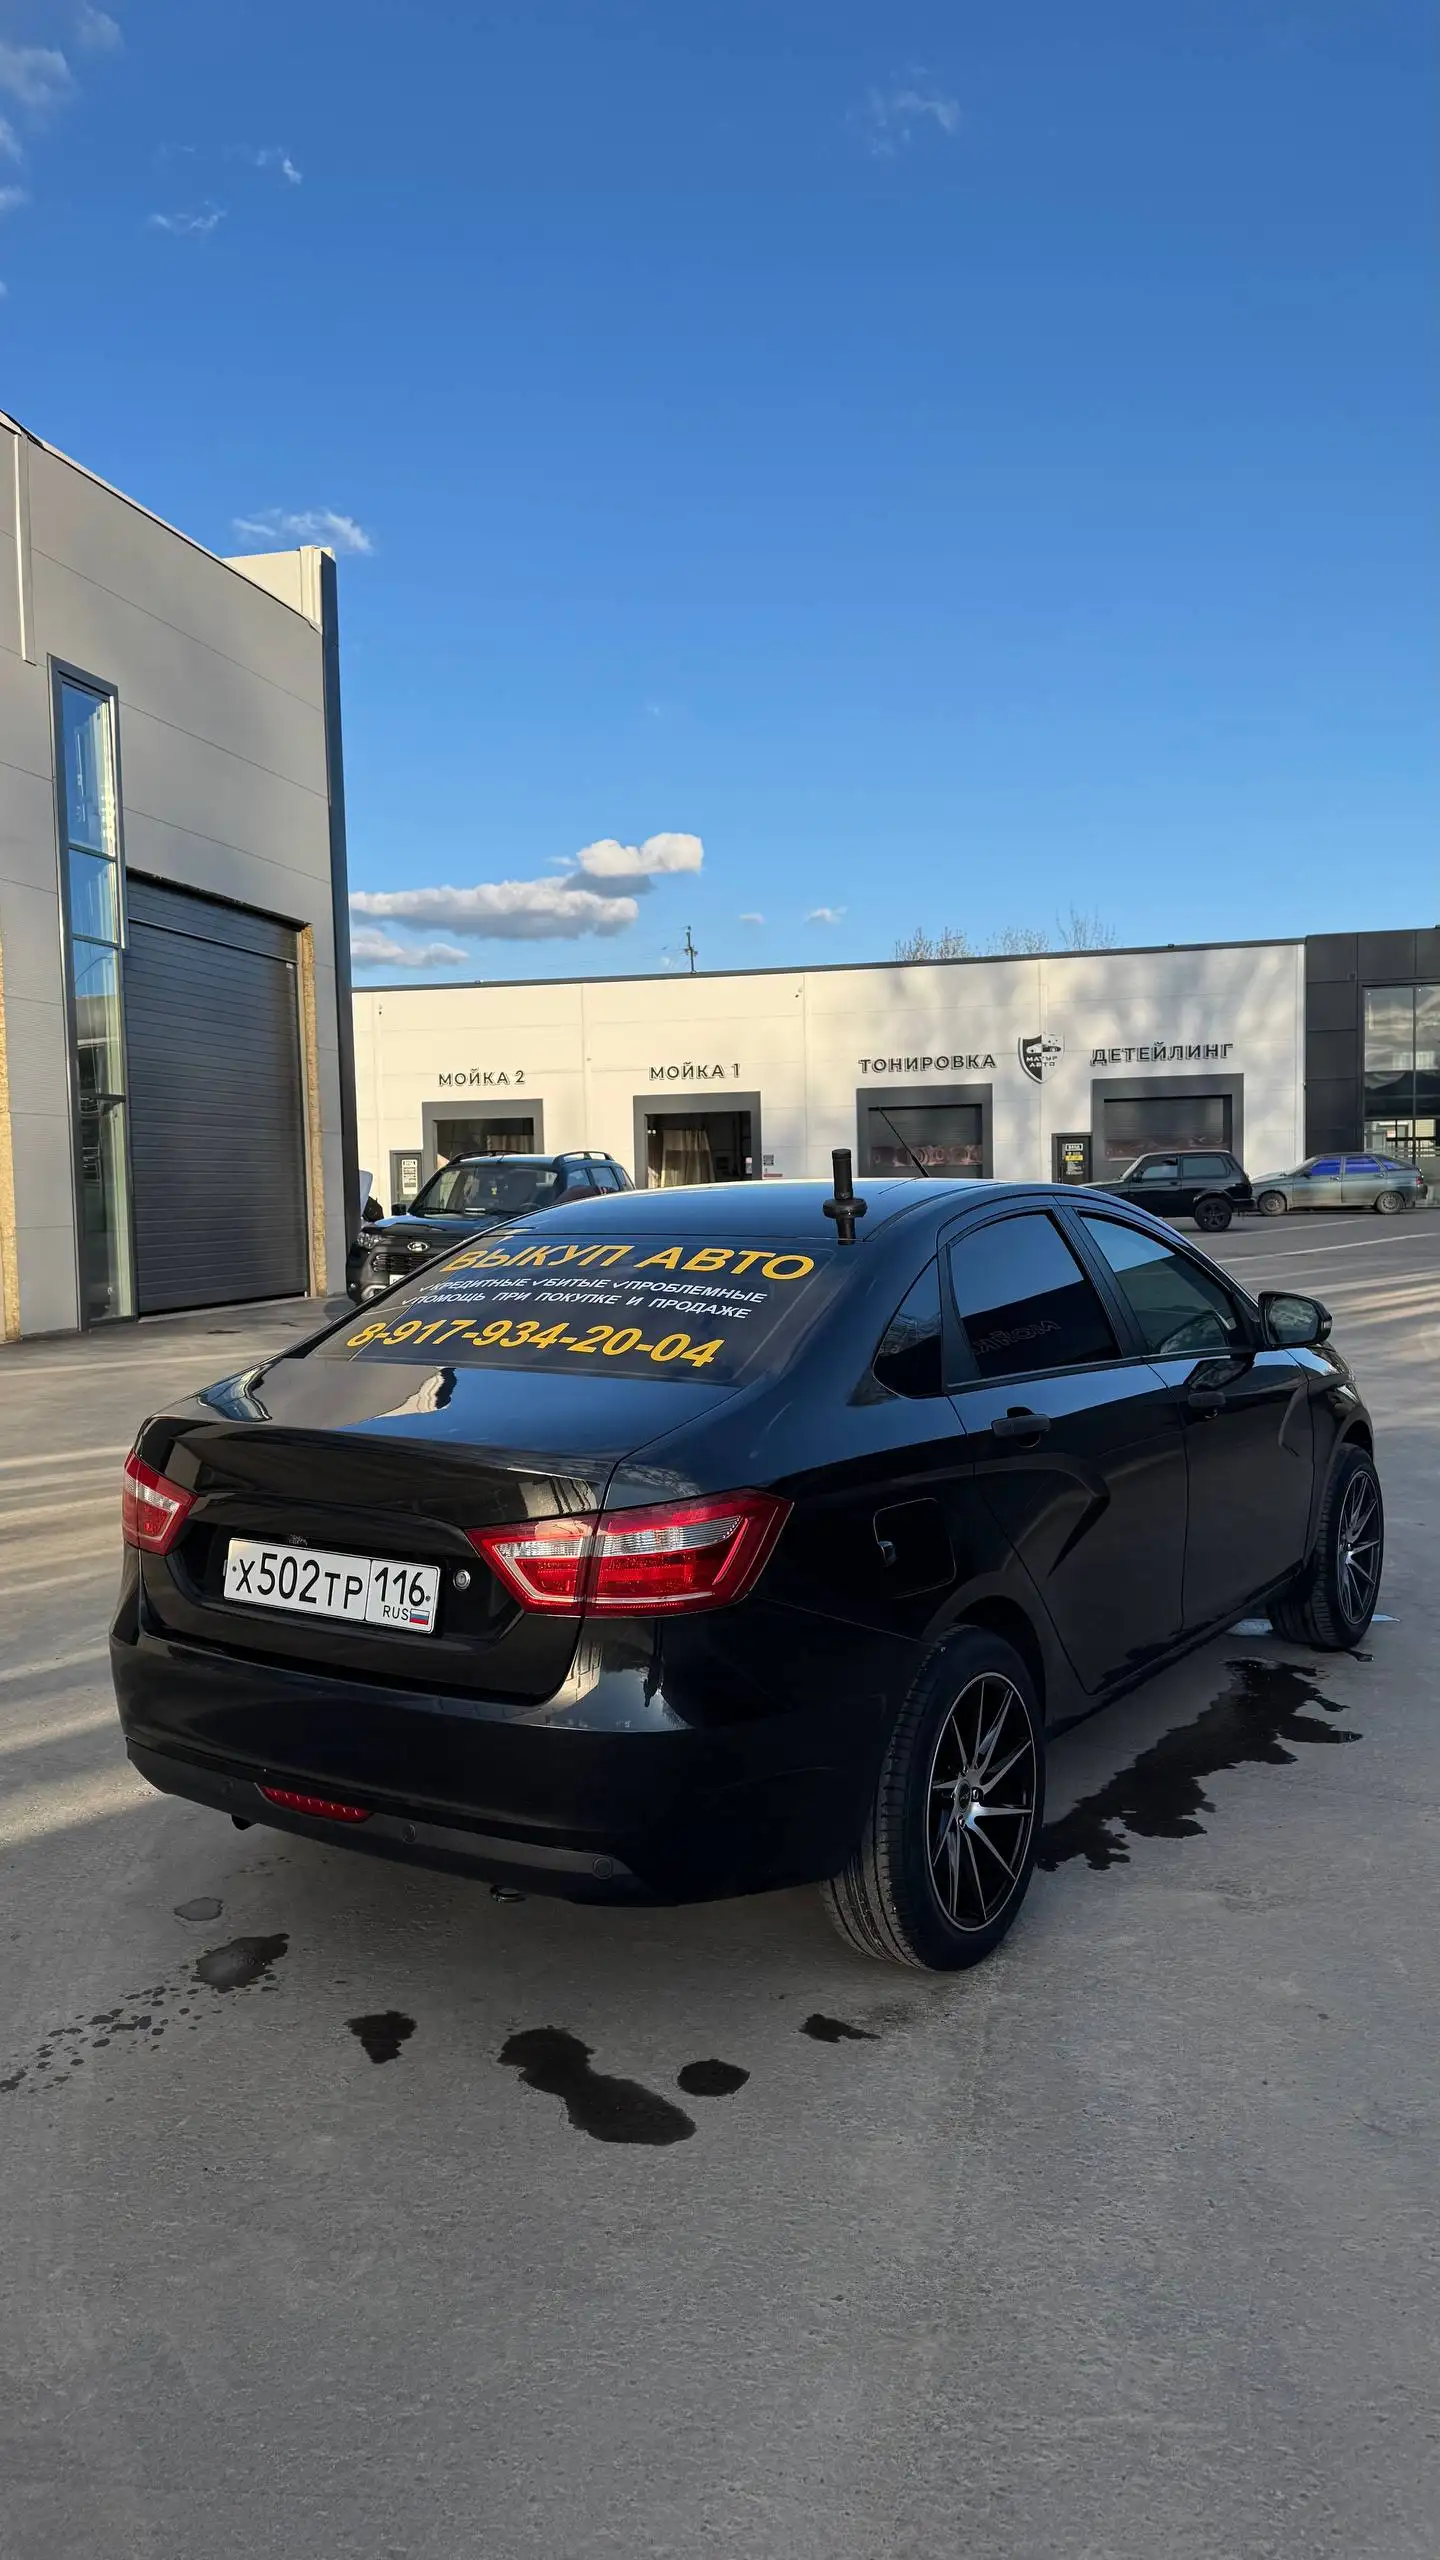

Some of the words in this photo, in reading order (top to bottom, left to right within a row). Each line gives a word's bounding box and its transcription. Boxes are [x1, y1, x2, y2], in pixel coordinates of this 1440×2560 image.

[859, 1054, 997, 1073] ТОНИРОВКА
[1090, 1041, 1233, 1066] ДЕТЕЙЛИНГ
[438, 1068, 509, 1086] МОЙКА
[515, 1070, 525, 1083] 2
[649, 1061, 725, 1080] МОЙКА
[731, 1063, 740, 1078] 1
[440, 1245, 635, 1272] ВЫКУП
[633, 1246, 815, 1280] АВТО
[429, 1278, 531, 1291] КРЕДИТНЫЕ
[543, 1278, 611, 1288] БИТЫЕ
[623, 1280, 768, 1304] ПРОБЛЕМНЫЕ
[411, 1292, 486, 1305] ПОМОЩЬ
[492, 1291, 533, 1301] ПРИ
[534, 1292, 622, 1305] ПОКУПКЕ
[625, 1296, 645, 1306] И
[649, 1298, 753, 1319] ПРОДАЖЕ
[347, 1319, 726, 1368] 8-917-934-20-04
[374, 1566, 426, 1607] 116
[382, 1604, 410, 1621] RUS
